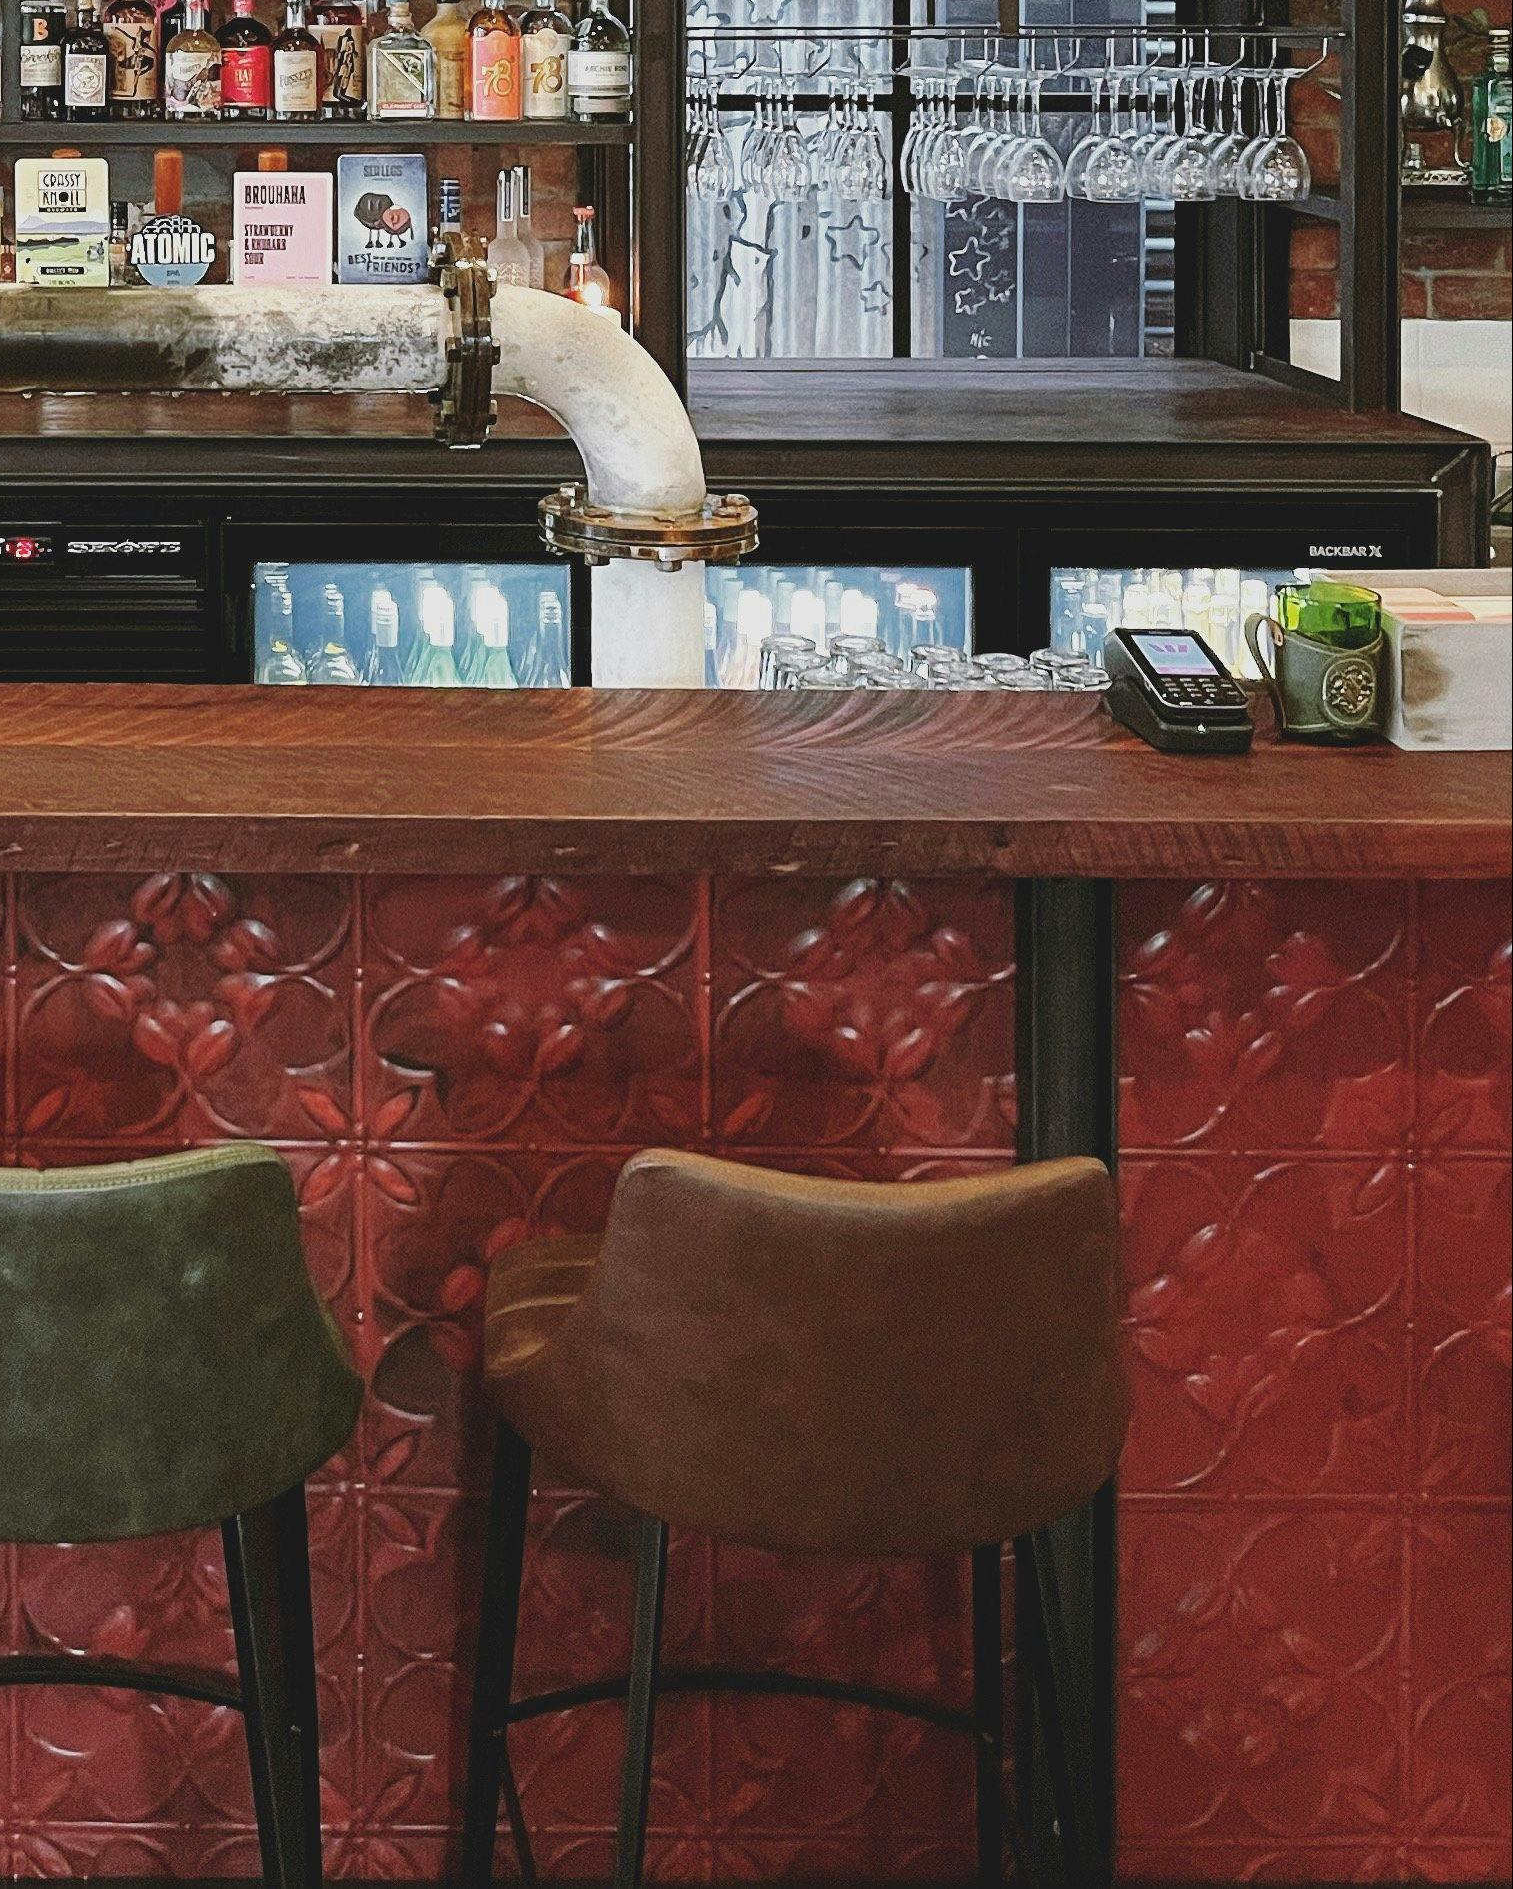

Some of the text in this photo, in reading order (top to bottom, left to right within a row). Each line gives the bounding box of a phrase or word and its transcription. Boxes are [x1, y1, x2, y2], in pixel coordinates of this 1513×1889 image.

[32, 18, 49, 41] B
[244, 185, 306, 205] BROUHAHA
[244, 224, 294, 237] STRAWBERRY
[131, 232, 215, 265] ATOMIC
[244, 238, 287, 251] & RHUBARB
[244, 252, 265, 265] SOUR
[348, 253, 373, 265] BEST
[366, 261, 421, 274] FRIENDS?
[1309, 545, 1367, 557] BACKBAR
